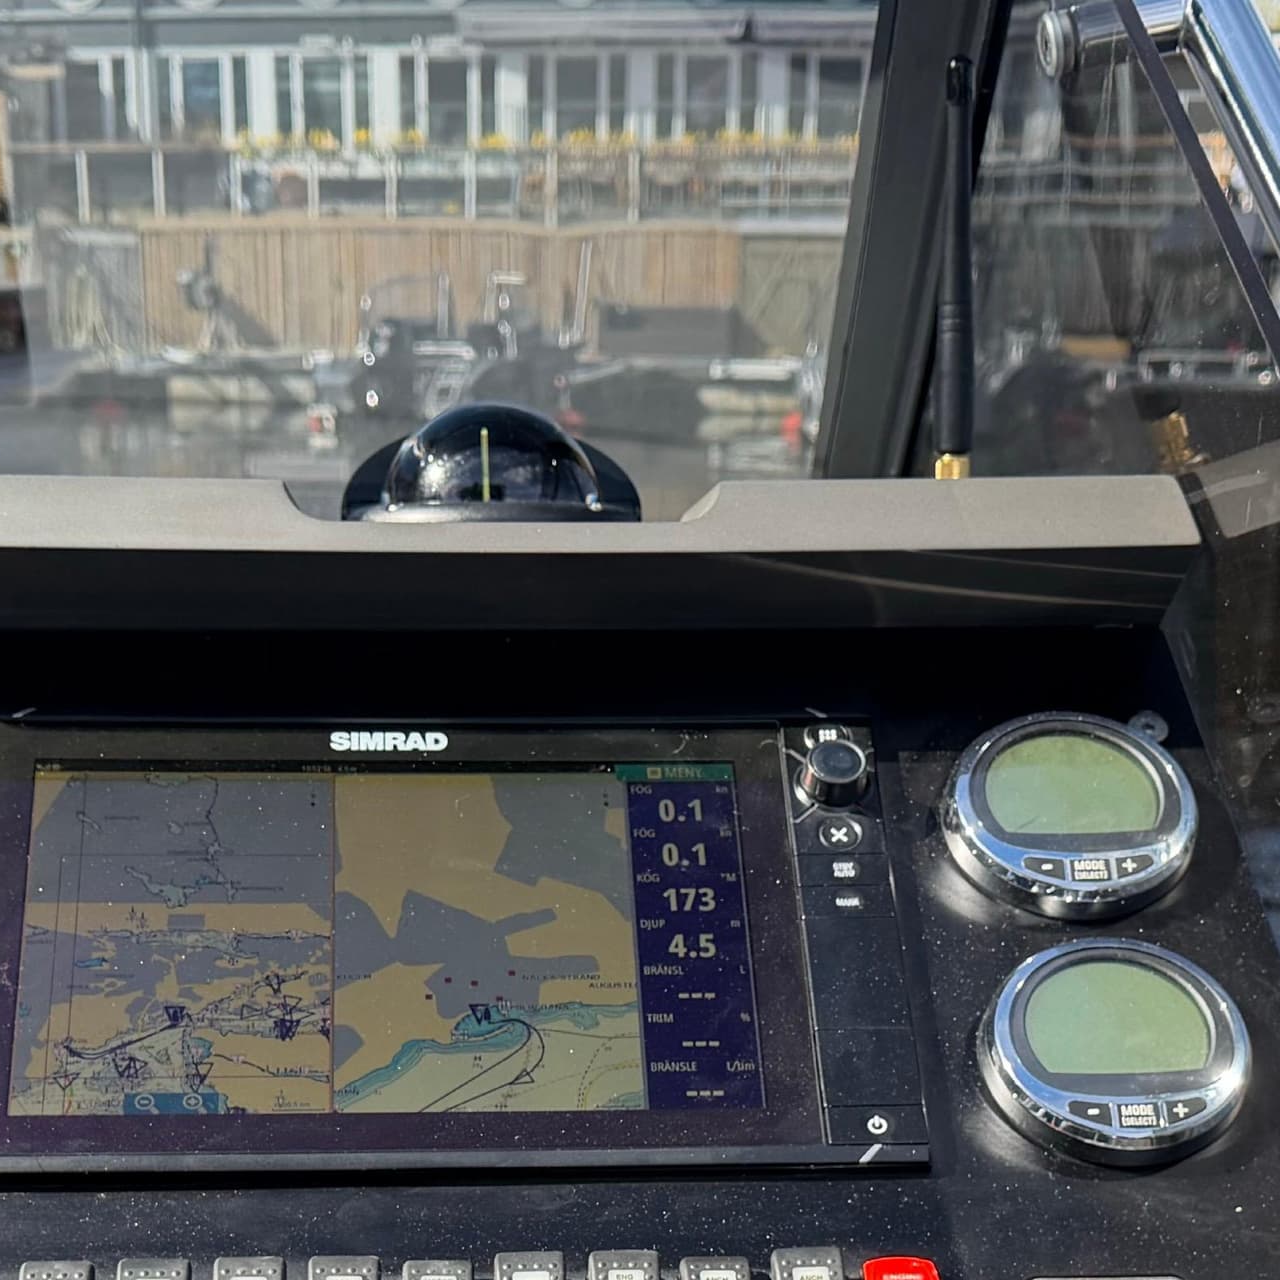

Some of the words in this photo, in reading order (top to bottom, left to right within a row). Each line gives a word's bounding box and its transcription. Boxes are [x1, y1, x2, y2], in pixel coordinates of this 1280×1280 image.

[329, 729, 449, 753] SIMRAD
[664, 767, 703, 778] MENY
[658, 799, 704, 822] 0.1
[662, 843, 707, 867] 0.1
[1074, 860, 1106, 870] MODE
[662, 888, 716, 912] 173
[639, 919, 666, 931] DJUP
[667, 933, 717, 959] 4.5
[647, 1013, 674, 1023] TRIM
[1120, 1104, 1155, 1116] MODE
[615, 1273, 634, 1280] ENG
